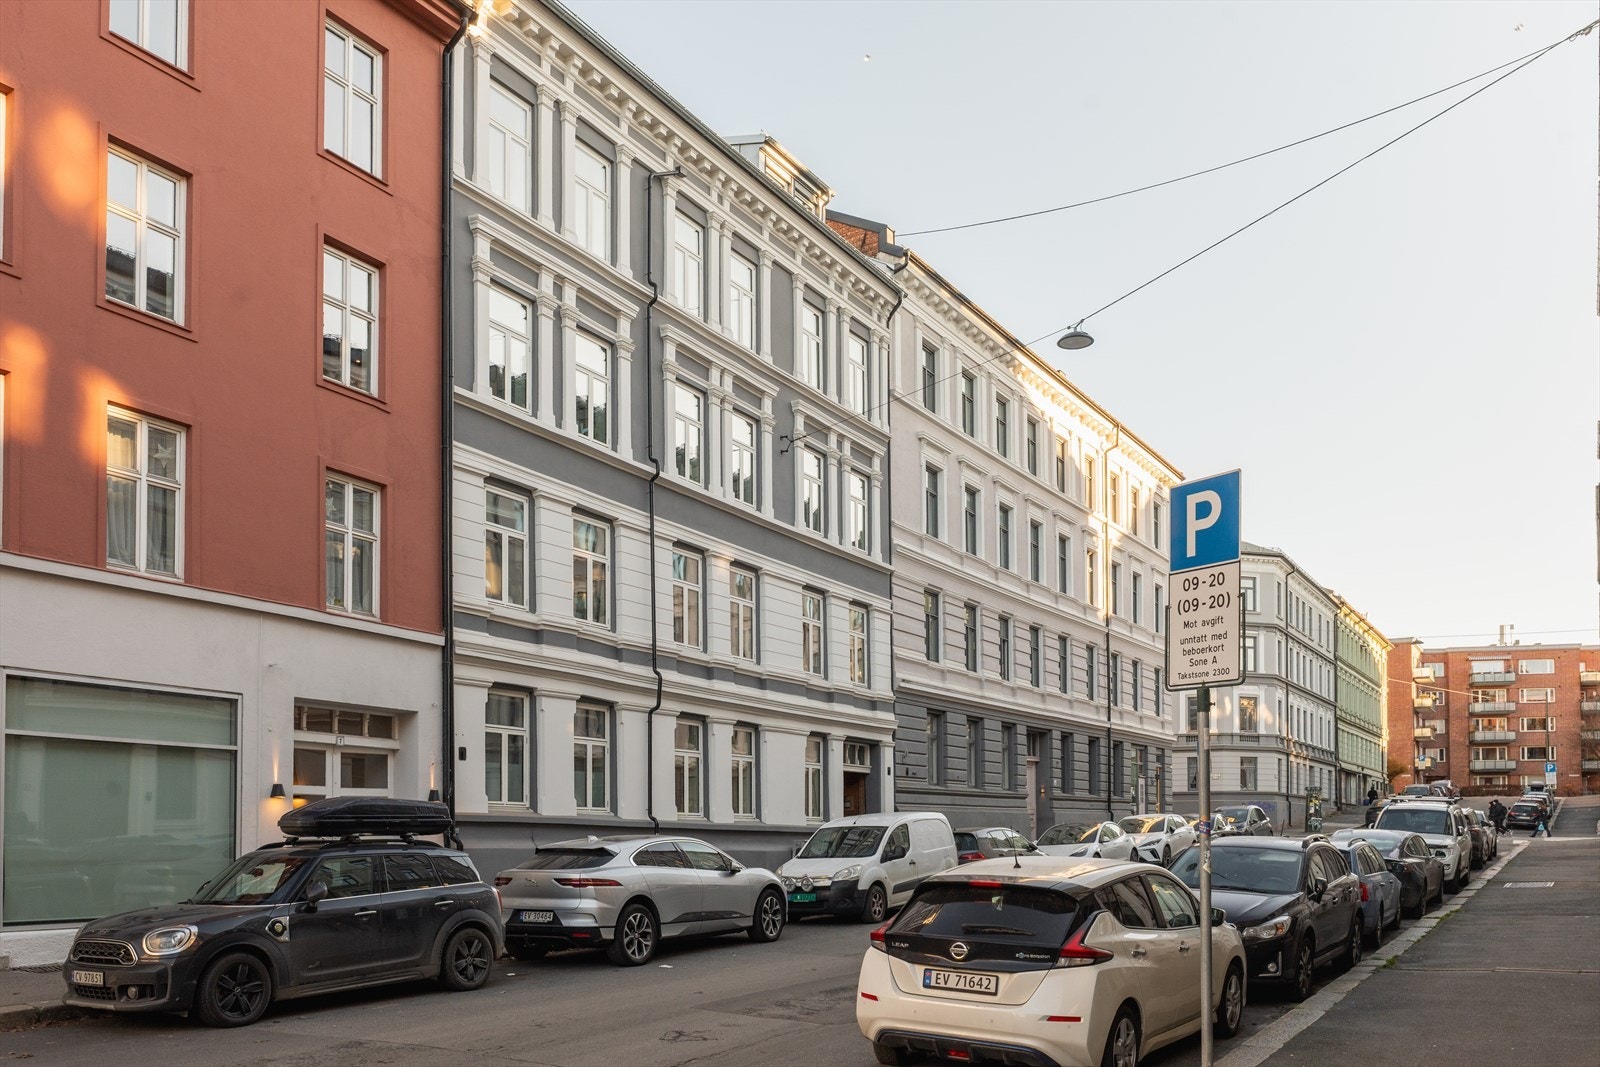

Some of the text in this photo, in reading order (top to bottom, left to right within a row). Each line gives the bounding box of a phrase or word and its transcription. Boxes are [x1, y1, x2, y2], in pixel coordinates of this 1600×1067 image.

[1186, 489, 1222, 558] P
[1183, 615, 1224, 630] Mot avgift
[1179, 630, 1228, 645] unntatt med
[1182, 643, 1225, 657] beboerkort
[1189, 655, 1218, 667] Sone A
[1177, 667, 1230, 680] Takstsone 2300
[75, 971, 102, 983] CV 97851
[935, 972, 992, 990] EV 71642
